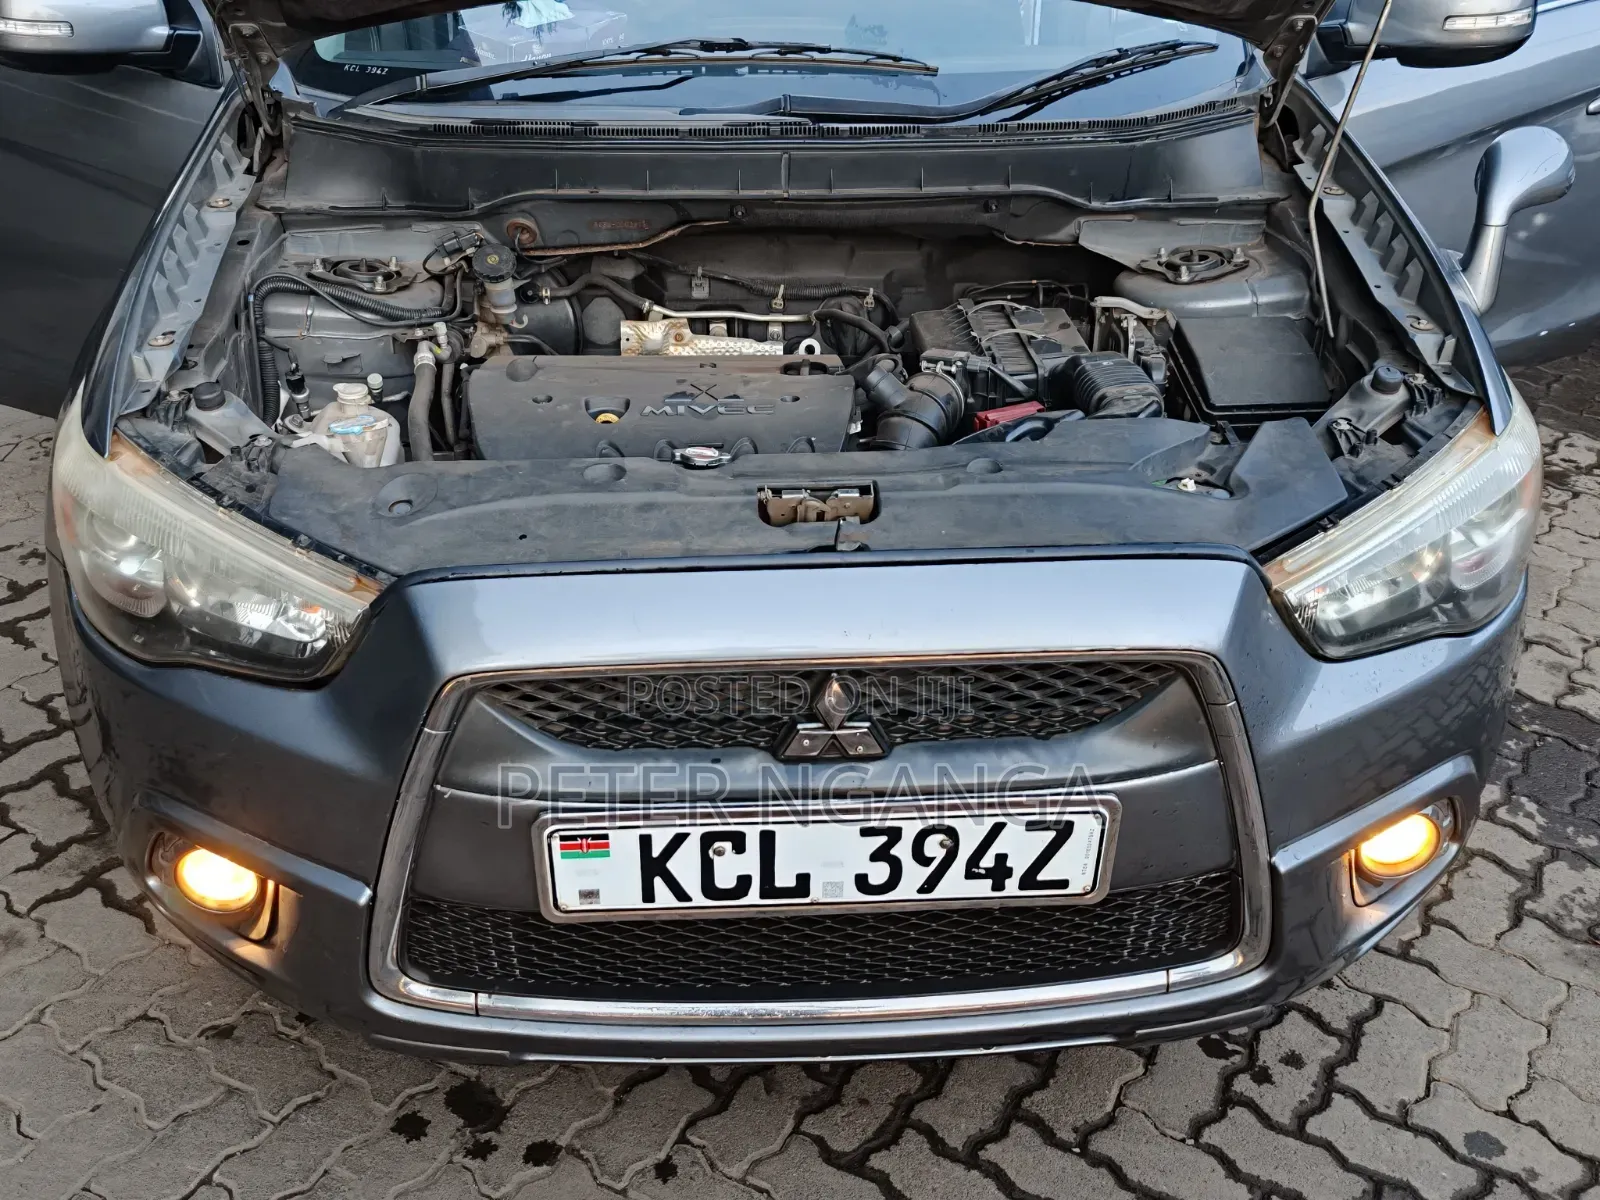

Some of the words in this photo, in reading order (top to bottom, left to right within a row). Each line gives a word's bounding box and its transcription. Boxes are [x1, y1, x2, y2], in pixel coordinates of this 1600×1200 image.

[344, 64, 360, 72] KCL
[640, 405, 775, 416] MIVEC
[639, 829, 811, 903] KCL
[854, 819, 1075, 896] 394Z
